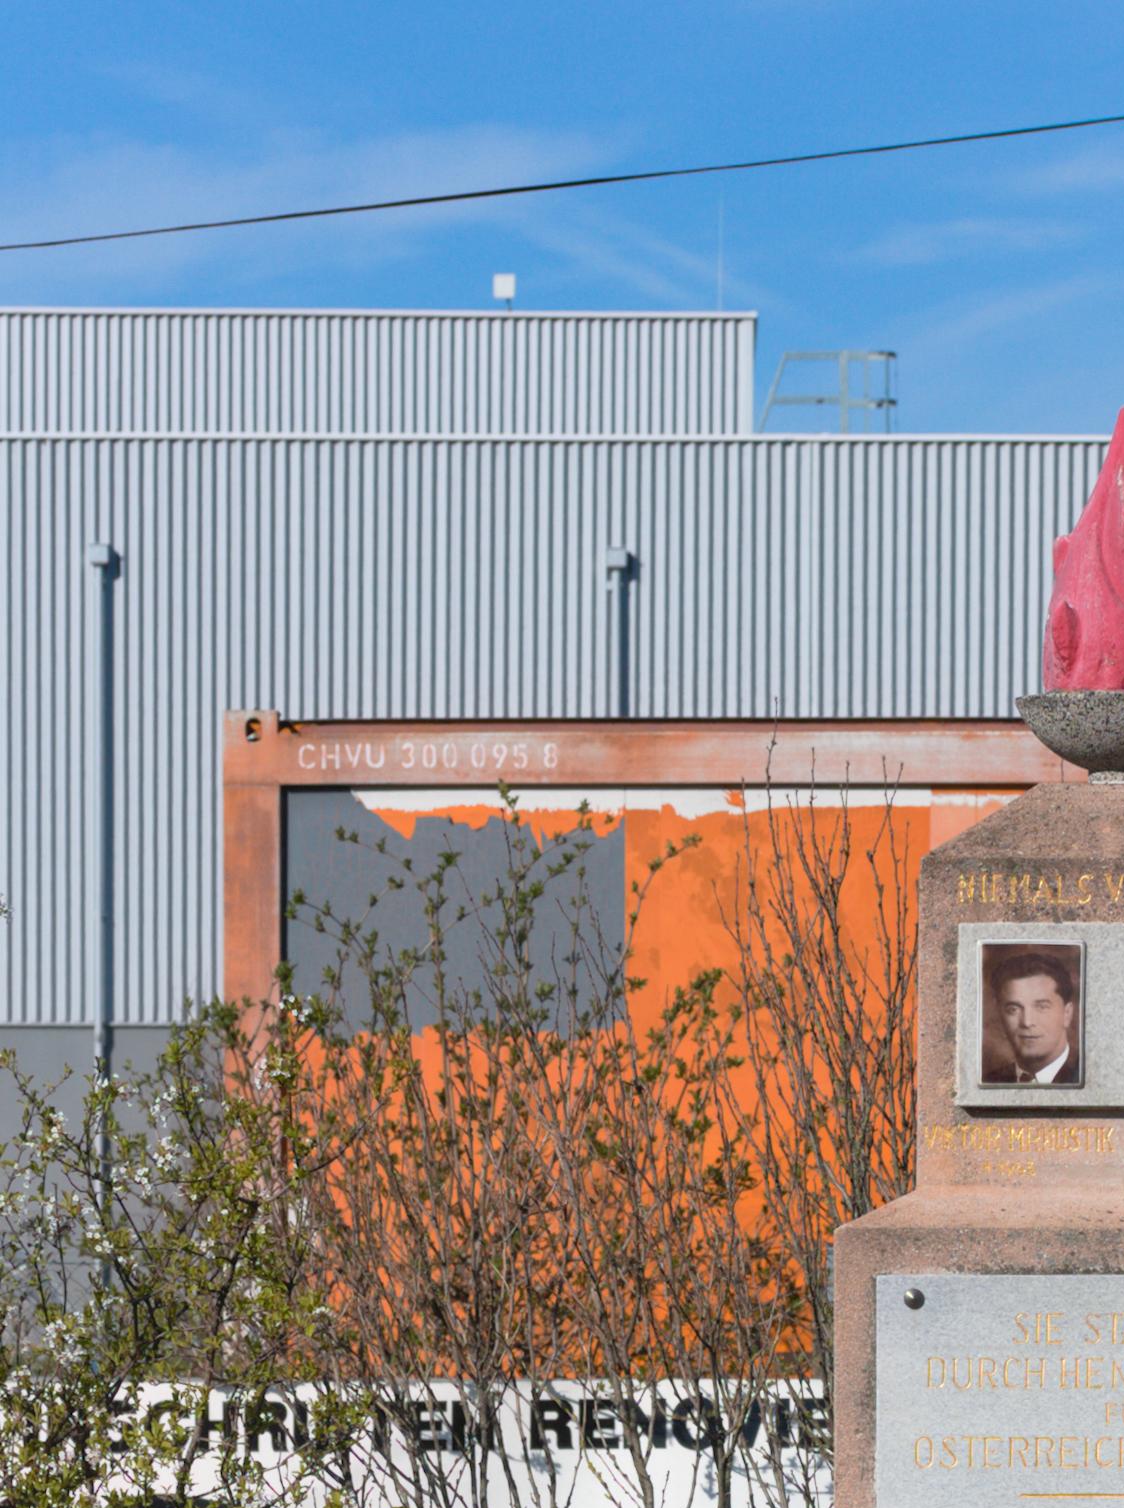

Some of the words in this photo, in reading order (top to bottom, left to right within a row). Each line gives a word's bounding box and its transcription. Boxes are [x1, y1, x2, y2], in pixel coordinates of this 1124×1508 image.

[297, 743, 385, 770] CHVU
[400, 742, 458, 769] 300
[471, 743, 529, 770] 095
[543, 742, 559, 768] 8
[957, 871, 1094, 905] NIEMALS
[1012, 1311, 1061, 1345] SIE
[927, 1356, 1046, 1391] DURCH
